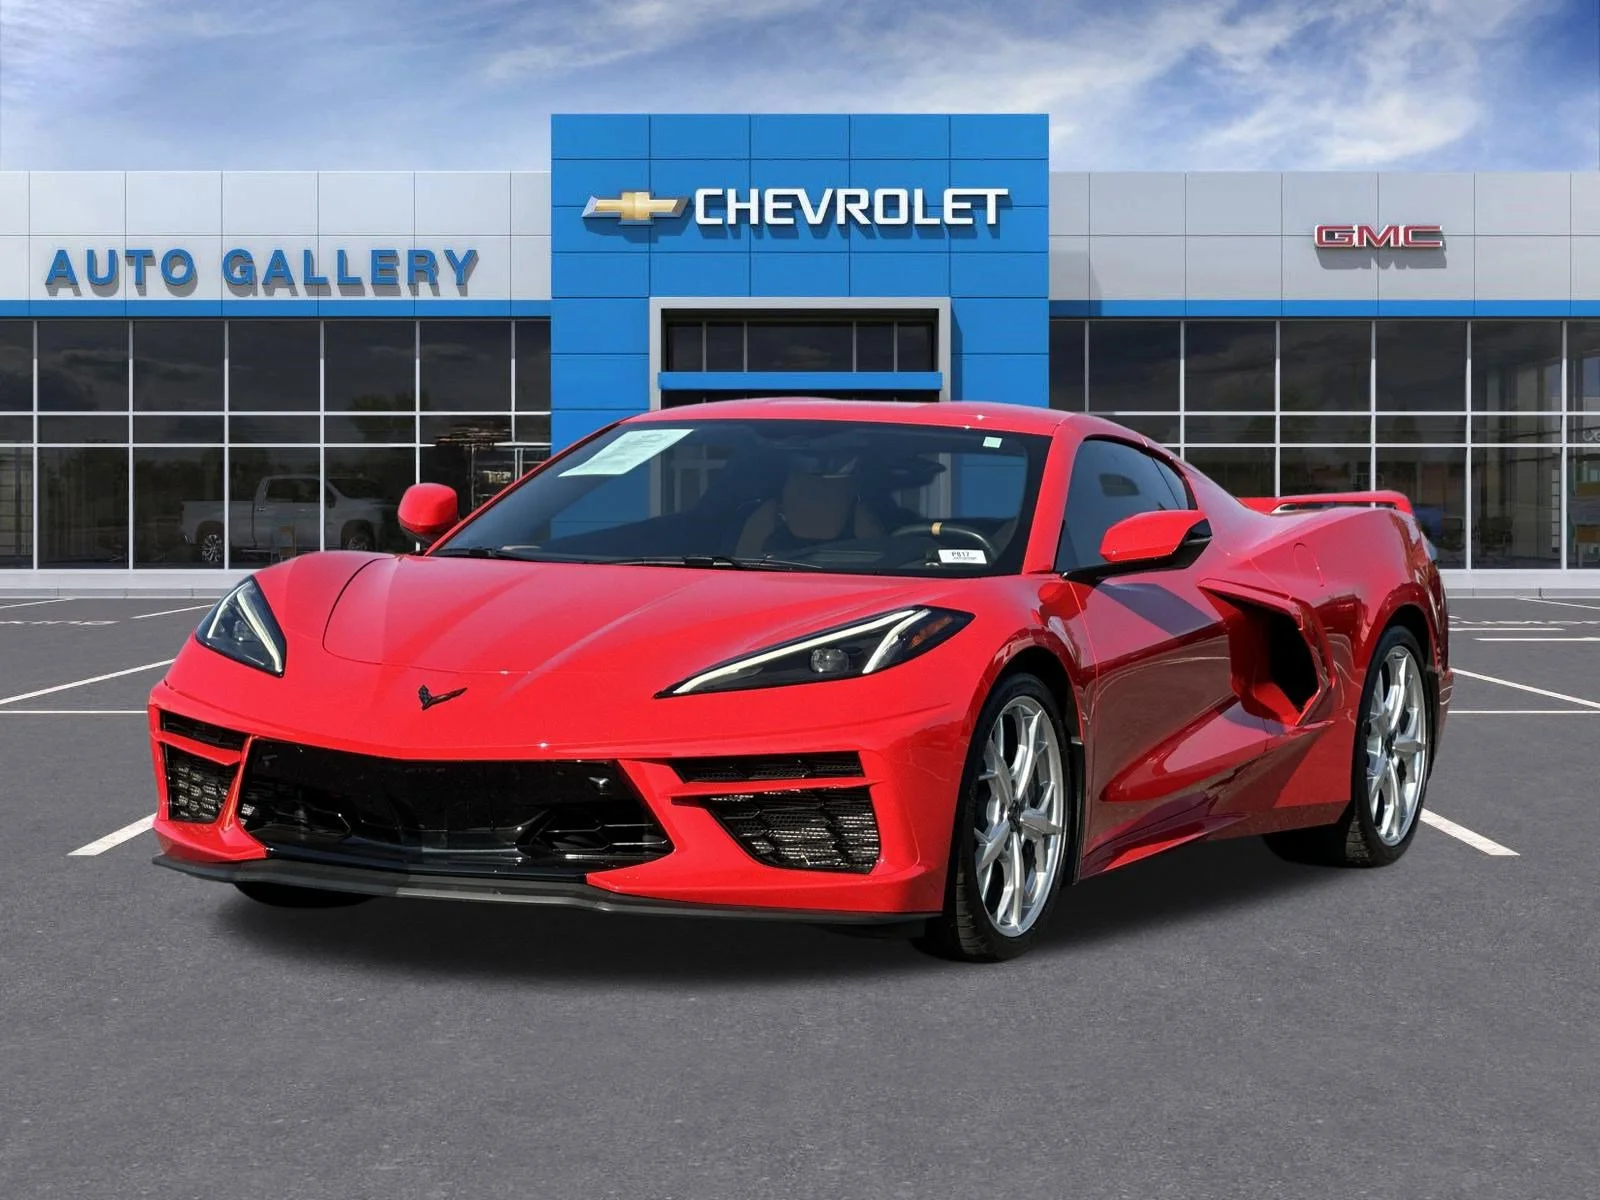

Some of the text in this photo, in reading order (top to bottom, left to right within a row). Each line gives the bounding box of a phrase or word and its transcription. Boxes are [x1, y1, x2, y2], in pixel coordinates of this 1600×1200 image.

[695, 188, 1009, 225] CHEVROLET
[1314, 224, 1442, 248] GMC
[46, 248, 476, 286] AUTO GALLERY
